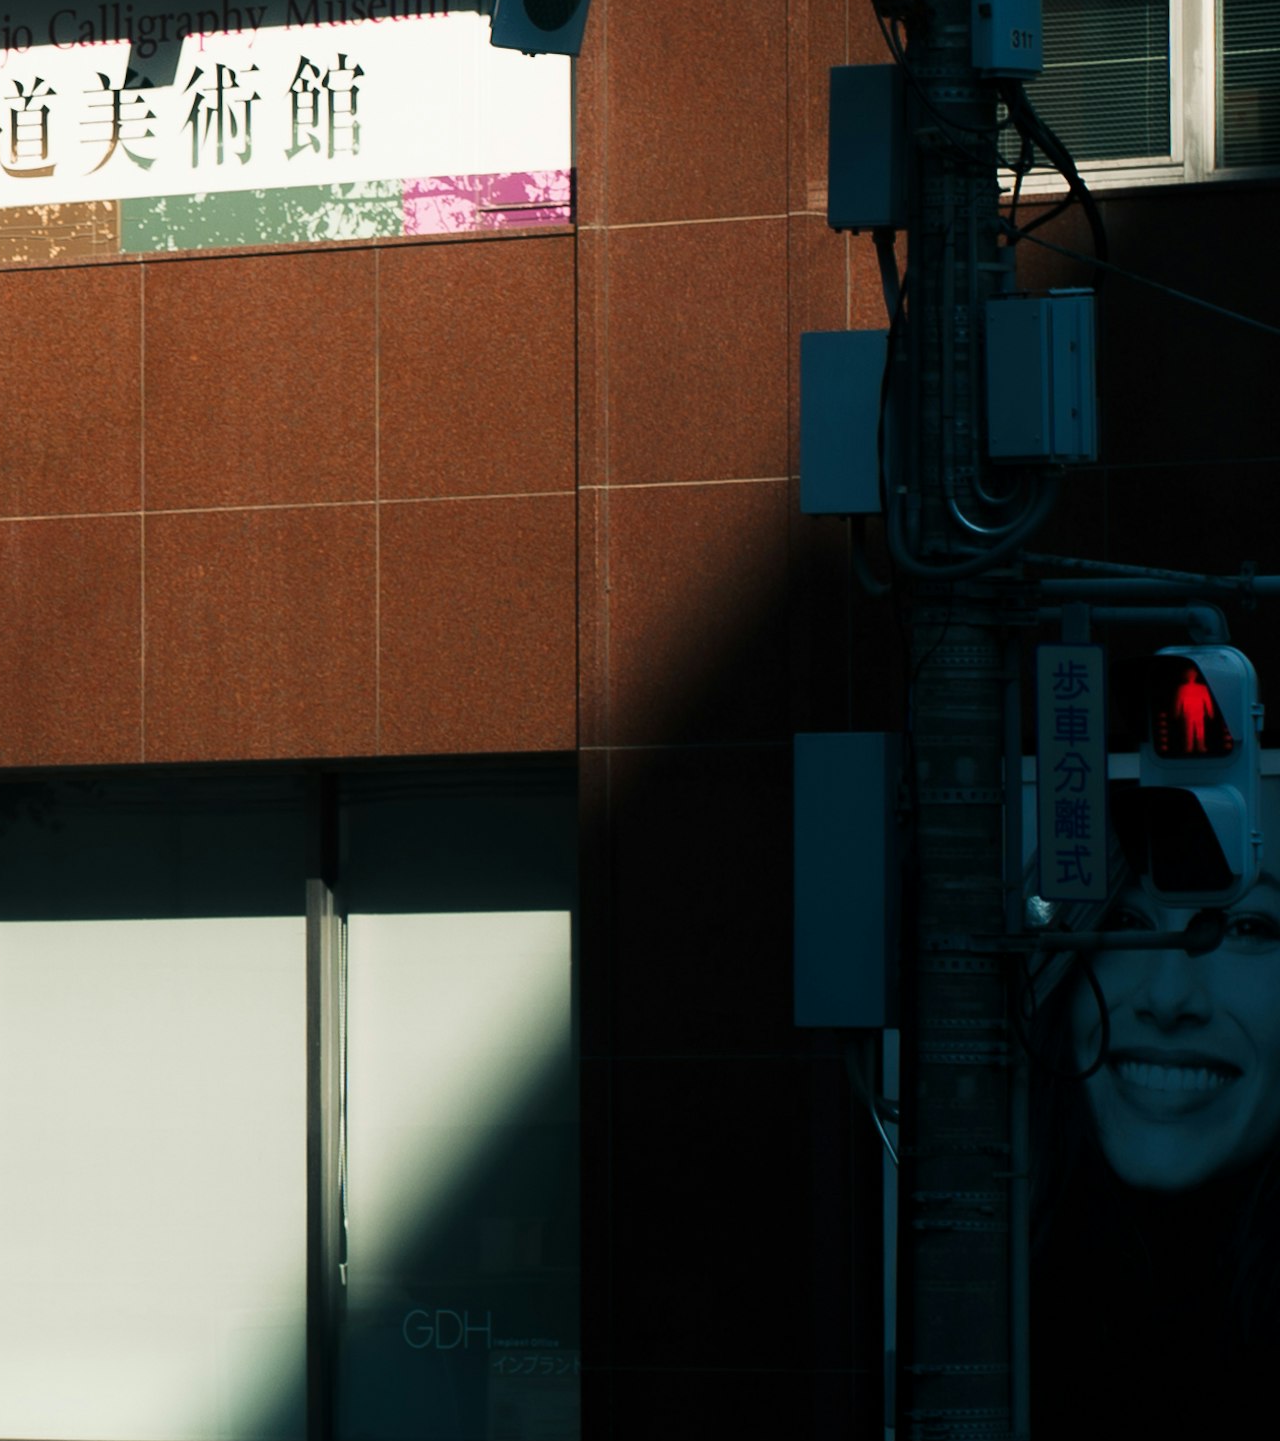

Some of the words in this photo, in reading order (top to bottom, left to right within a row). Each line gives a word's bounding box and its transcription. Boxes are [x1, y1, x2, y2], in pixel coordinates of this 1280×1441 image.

[1052, 660, 1091, 887] 歩車分離式
[402, 1309, 491, 1349] GDH
